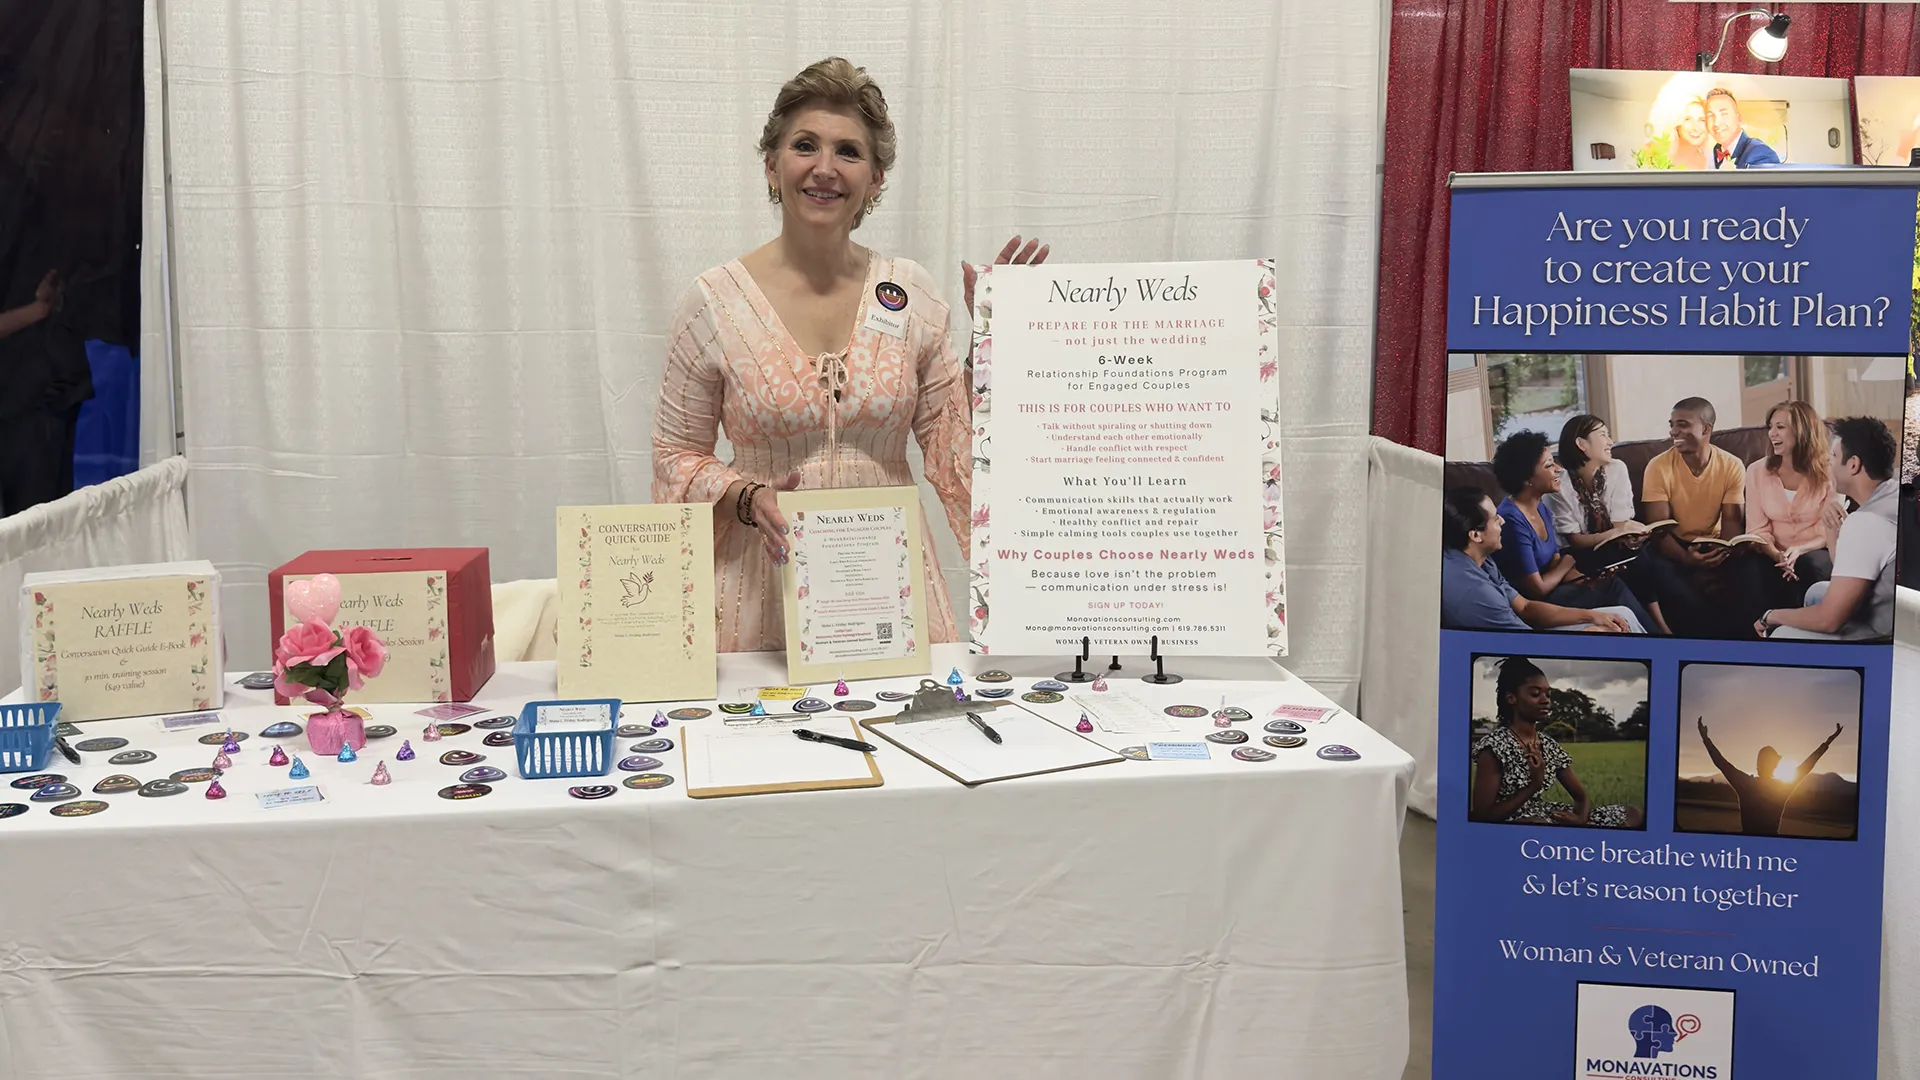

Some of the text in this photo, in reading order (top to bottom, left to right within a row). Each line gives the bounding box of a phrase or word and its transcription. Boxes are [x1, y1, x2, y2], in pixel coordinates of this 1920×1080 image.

[1546, 206, 1809, 248] Are you ready
[1545, 257, 1809, 290] to create your
[1048, 275, 1197, 311] Nearly Weds
[1473, 292, 1890, 335] Happiness Habit Plan?
[871, 314, 900, 329] Exhibitor
[1029, 319, 1224, 330] PREPARE FOR THE MARRIAGE
[1091, 336, 1116, 347] just
[1124, 336, 1144, 344] the
[1151, 335, 1206, 345] wedding
[1099, 355, 1153, 365] 6-Week
[1028, 369, 1227, 379] Relationship Foundations Program
[1068, 381, 1190, 392] for Engaged Couples
[1018, 402, 1230, 413] THIS IS FOR COUPLES WHO WANT TO
[1098, 423, 1136, 431] spiraling
[1150, 422, 1186, 430] shutting
[1152, 433, 1202, 441] emotionally
[1055, 456, 1093, 464] marriage
[1096, 456, 1125, 464] feeling
[1064, 476, 1097, 486] What
[1149, 477, 1186, 485] Learn
[1164, 496, 1204, 504] actually
[1163, 507, 1215, 516] regulation
[599, 523, 676, 533] CONVERSATION
[1060, 519, 1097, 527] Healthy
[1168, 518, 1198, 527] repair
[605, 534, 670, 545] QUICK GUIDE
[1021, 530, 1054, 538] Simple
[1058, 530, 1097, 539] calming
[1131, 530, 1169, 538] couples
[1194, 529, 1238, 538] together
[998, 549, 1254, 561] Why Couples Choose Nearly Weds
[609, 554, 665, 568] Nearly Weds
[1032, 570, 1080, 578] Because
[1085, 570, 1109, 578] love
[1145, 570, 1163, 578] the
[1168, 570, 1216, 579] problem
[1041, 583, 1128, 591] communication
[1214, 583, 1226, 591] is!
[340, 593, 404, 612] early Weds
[82, 600, 162, 621] Nearly Weds
[95, 620, 152, 638] RAFFLE
[1026, 625, 1169, 633] Mona@monavationsconsulting.com
[398, 637, 425, 646] Session
[61, 640, 187, 660] Conversation Quick Guide E-Book
[94, 672, 110, 680] min.
[112, 668, 142, 680] training
[143, 667, 167, 675] session
[122, 679, 146, 691] value)
[1521, 839, 1797, 872] Come breathe with me
[1523, 875, 1545, 894] &
[1605, 884, 1686, 902] reason
[1693, 884, 1798, 911] together
[1499, 940, 1818, 977] Woman & Veteran Owned
[1586, 1058, 1717, 1080] MONAVATIONS
